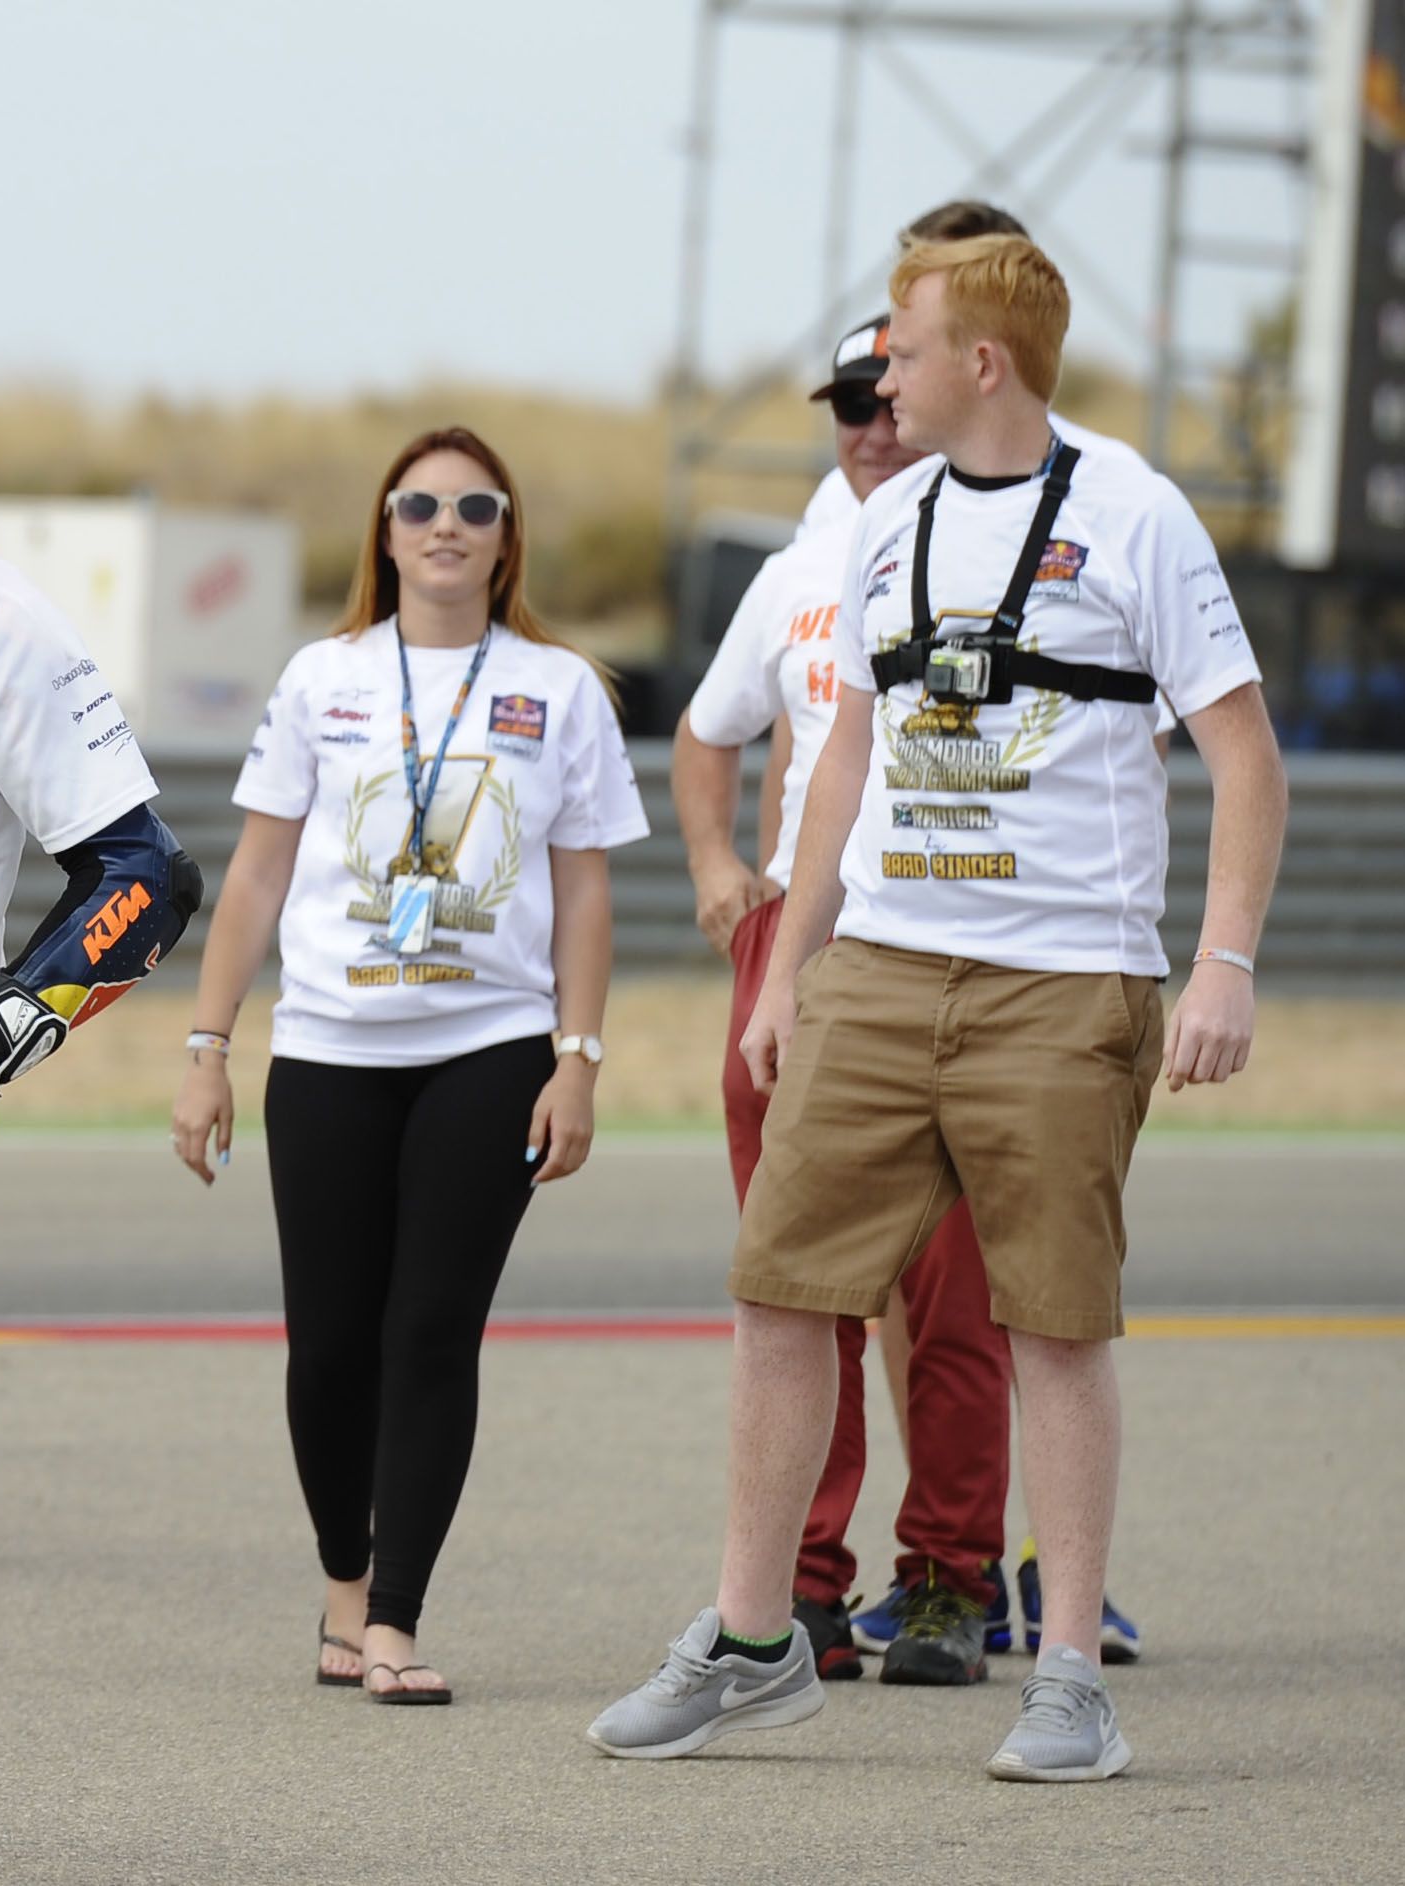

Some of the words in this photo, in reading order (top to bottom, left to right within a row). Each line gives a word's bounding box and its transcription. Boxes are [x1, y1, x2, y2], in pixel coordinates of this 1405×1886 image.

[926, 767, 1030, 793] CHAMPION
[882, 852, 928, 879] BRAD
[930, 853, 1017, 880] BINDER
[82, 881, 153, 966] KTM
